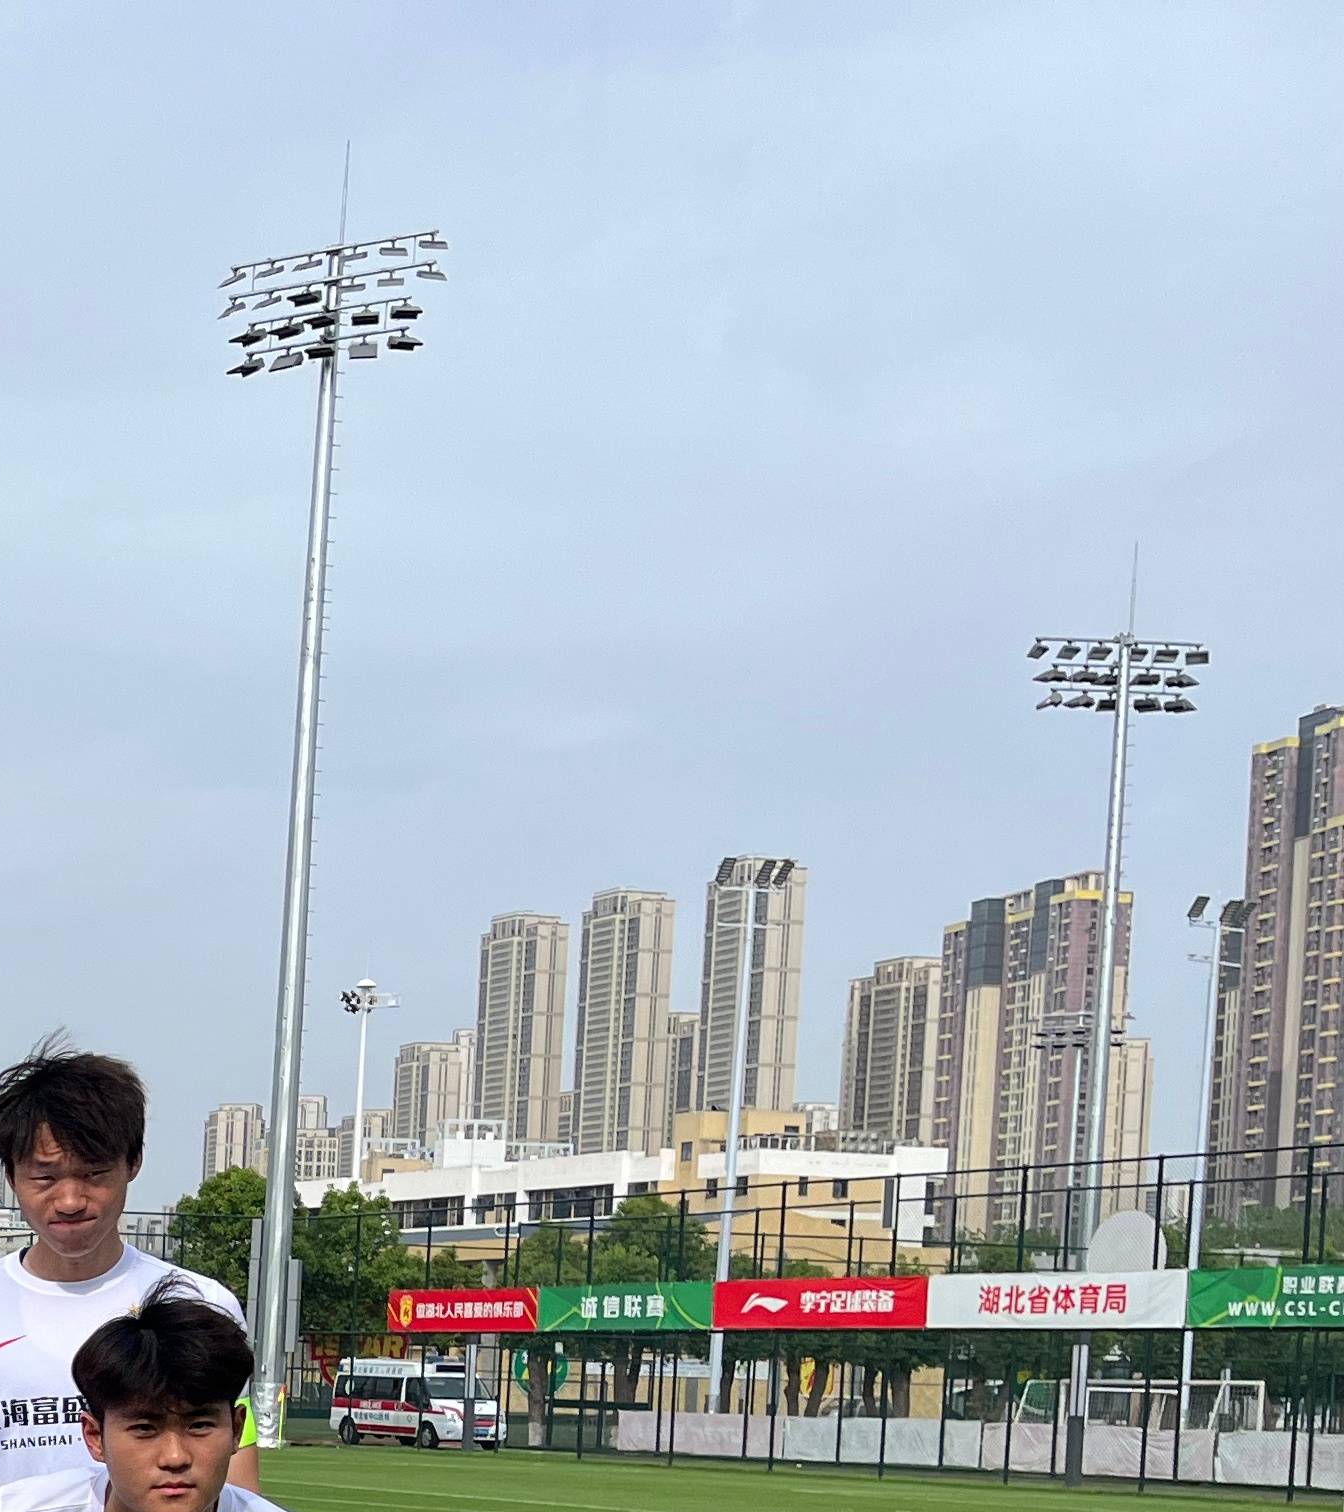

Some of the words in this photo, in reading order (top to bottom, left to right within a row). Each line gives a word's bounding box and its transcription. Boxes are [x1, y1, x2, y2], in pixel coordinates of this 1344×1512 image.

[580, 1294, 666, 1319] 诚信联赛
[978, 1284, 1128, 1315] 湖北省体育局
[1228, 1300, 1344, 1316] WWW.CSL-C
[0, 1435, 73, 1451] SHANGHAI
